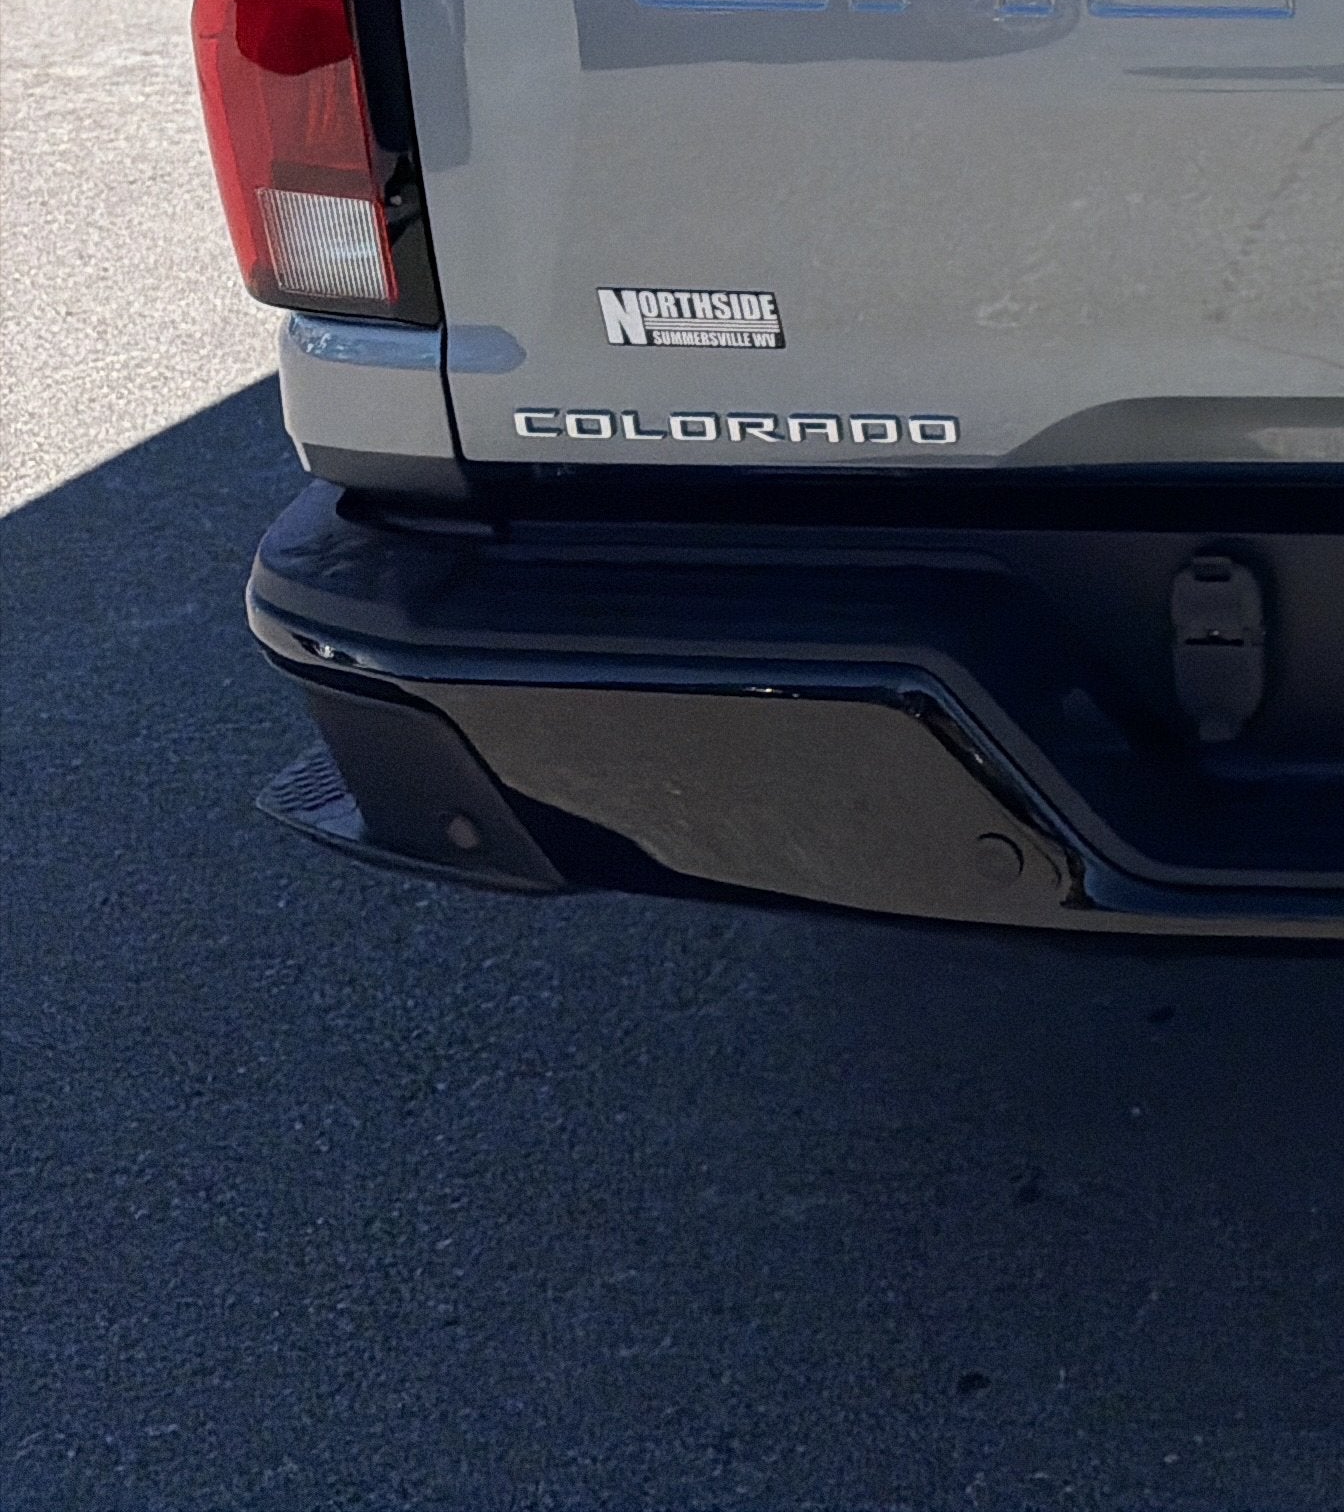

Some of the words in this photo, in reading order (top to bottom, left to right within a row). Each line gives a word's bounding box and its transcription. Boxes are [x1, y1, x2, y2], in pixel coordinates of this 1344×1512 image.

[598, 288, 779, 345] NORTHSIDE
[652, 329, 752, 347] SUMMERSVILLE
[752, 332, 776, 348] WV
[513, 405, 961, 444] COLORADO
